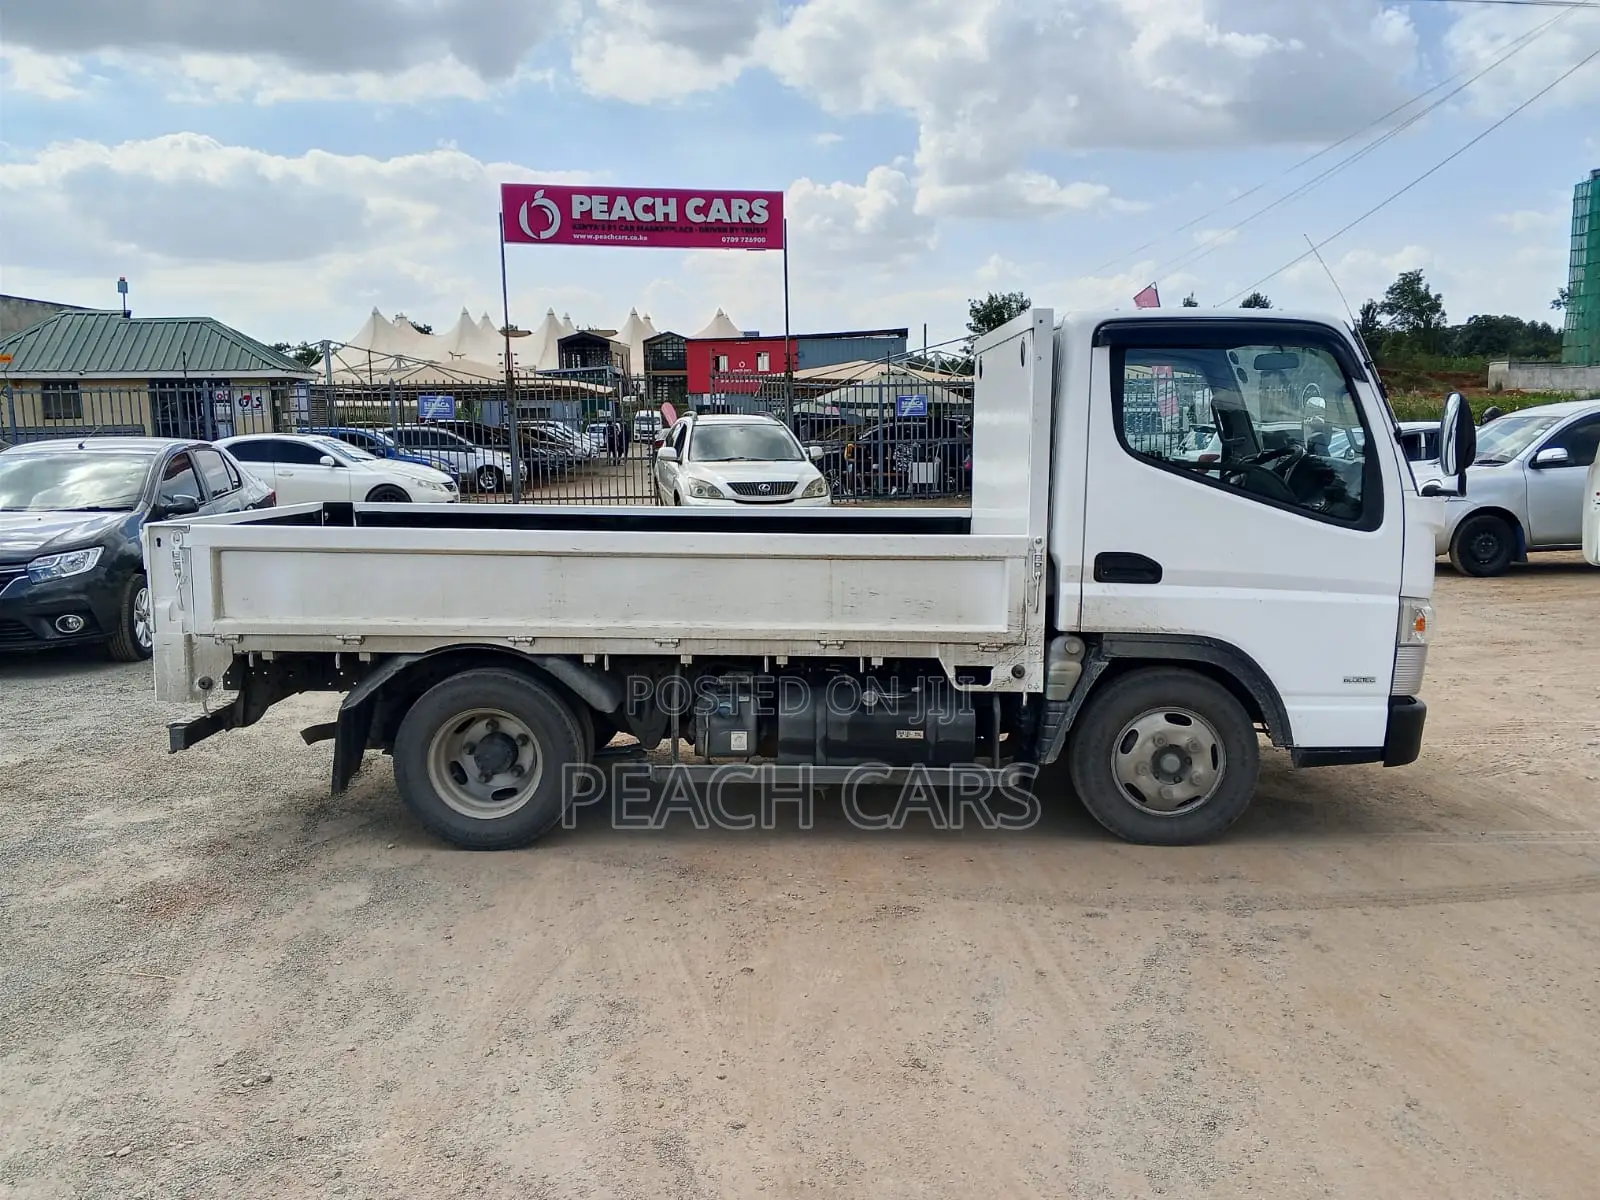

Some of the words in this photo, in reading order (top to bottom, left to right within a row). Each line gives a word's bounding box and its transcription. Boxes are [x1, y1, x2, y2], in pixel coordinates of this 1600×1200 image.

[571, 194, 678, 223] PEACH
[685, 197, 770, 225] CARS
[618, 224, 636, 233] CAR
